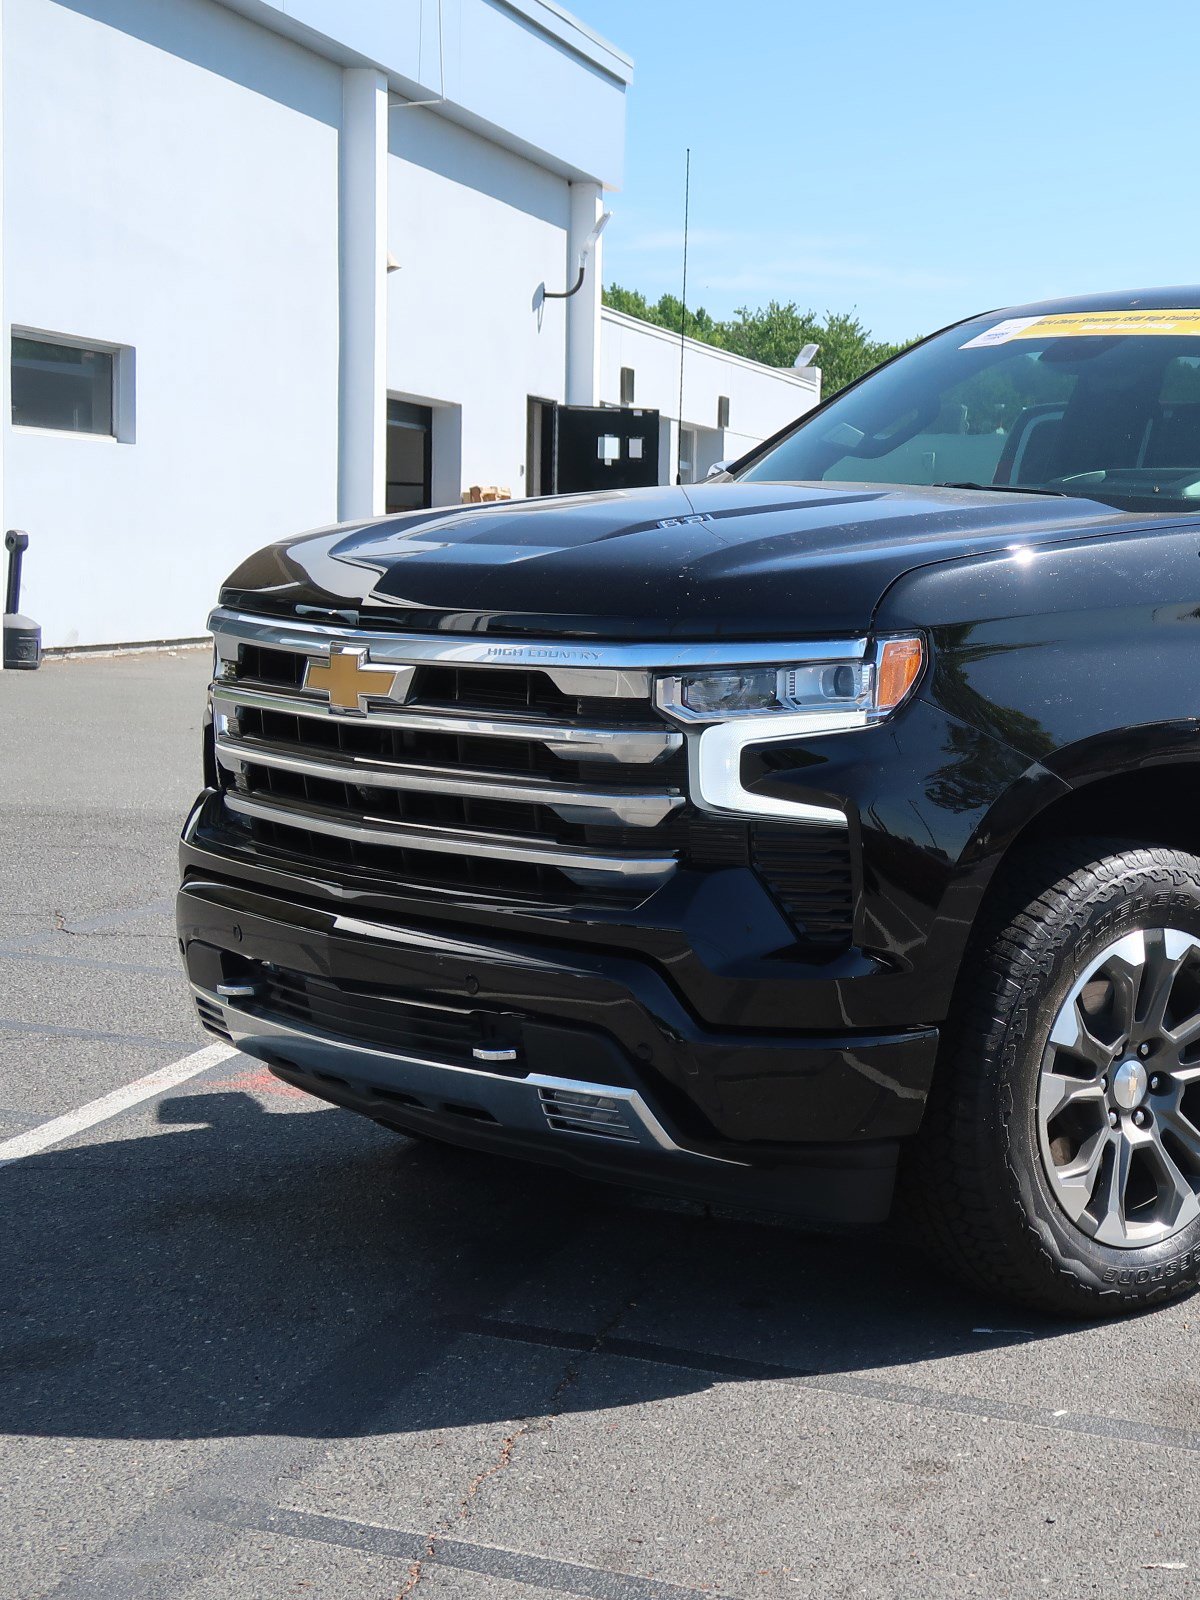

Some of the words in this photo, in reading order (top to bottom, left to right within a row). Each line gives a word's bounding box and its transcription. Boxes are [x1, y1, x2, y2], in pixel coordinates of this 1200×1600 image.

[487, 647, 524, 656] HIGH
[527, 648, 604, 661] COUNTRY
[1074, 889, 1192, 963] DUELER
